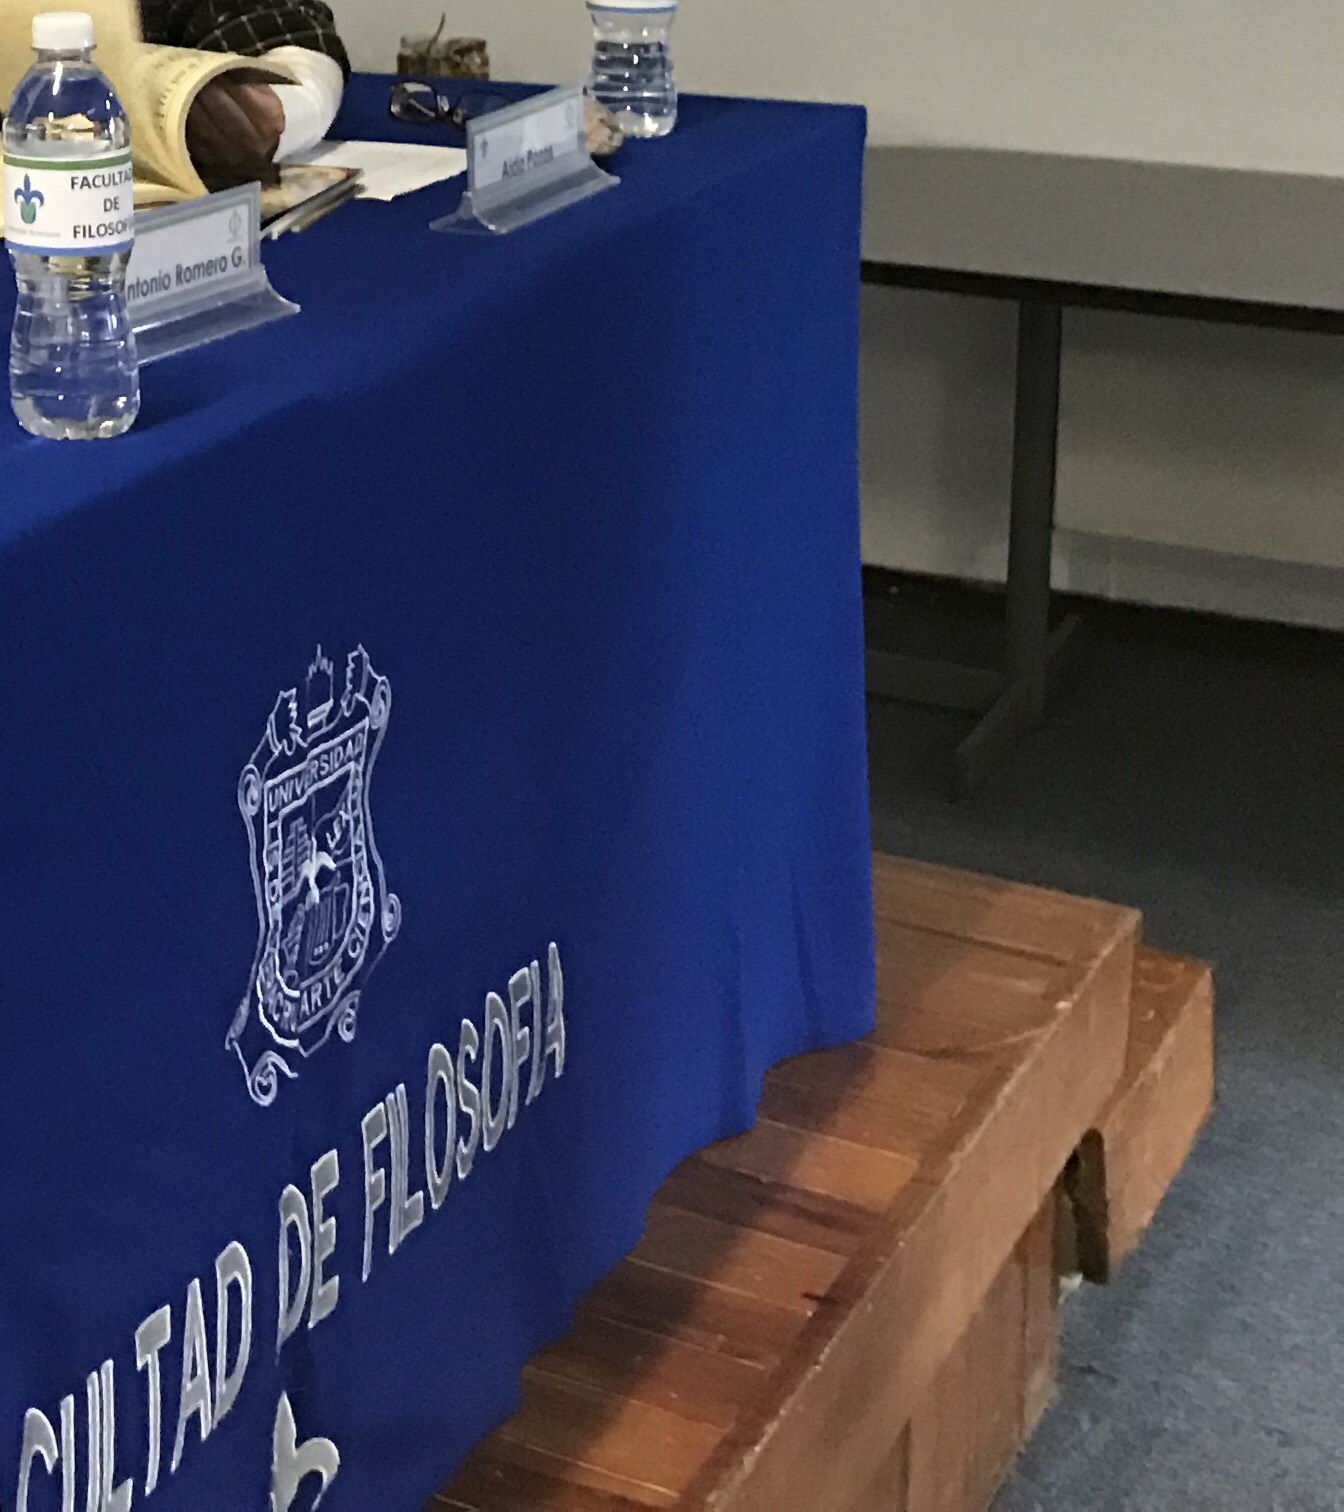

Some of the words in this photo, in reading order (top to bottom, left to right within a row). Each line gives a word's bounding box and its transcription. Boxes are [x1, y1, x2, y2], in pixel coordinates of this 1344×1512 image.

[70, 166, 133, 191] FACULTA
[103, 196, 120, 212] DE
[126, 269, 171, 300] ntonio
[175, 255, 227, 286] Romero
[230, 246, 246, 269] G.
[276, 1148, 340, 1365] DE
[361, 941, 566, 1284] FILOSOFIA
